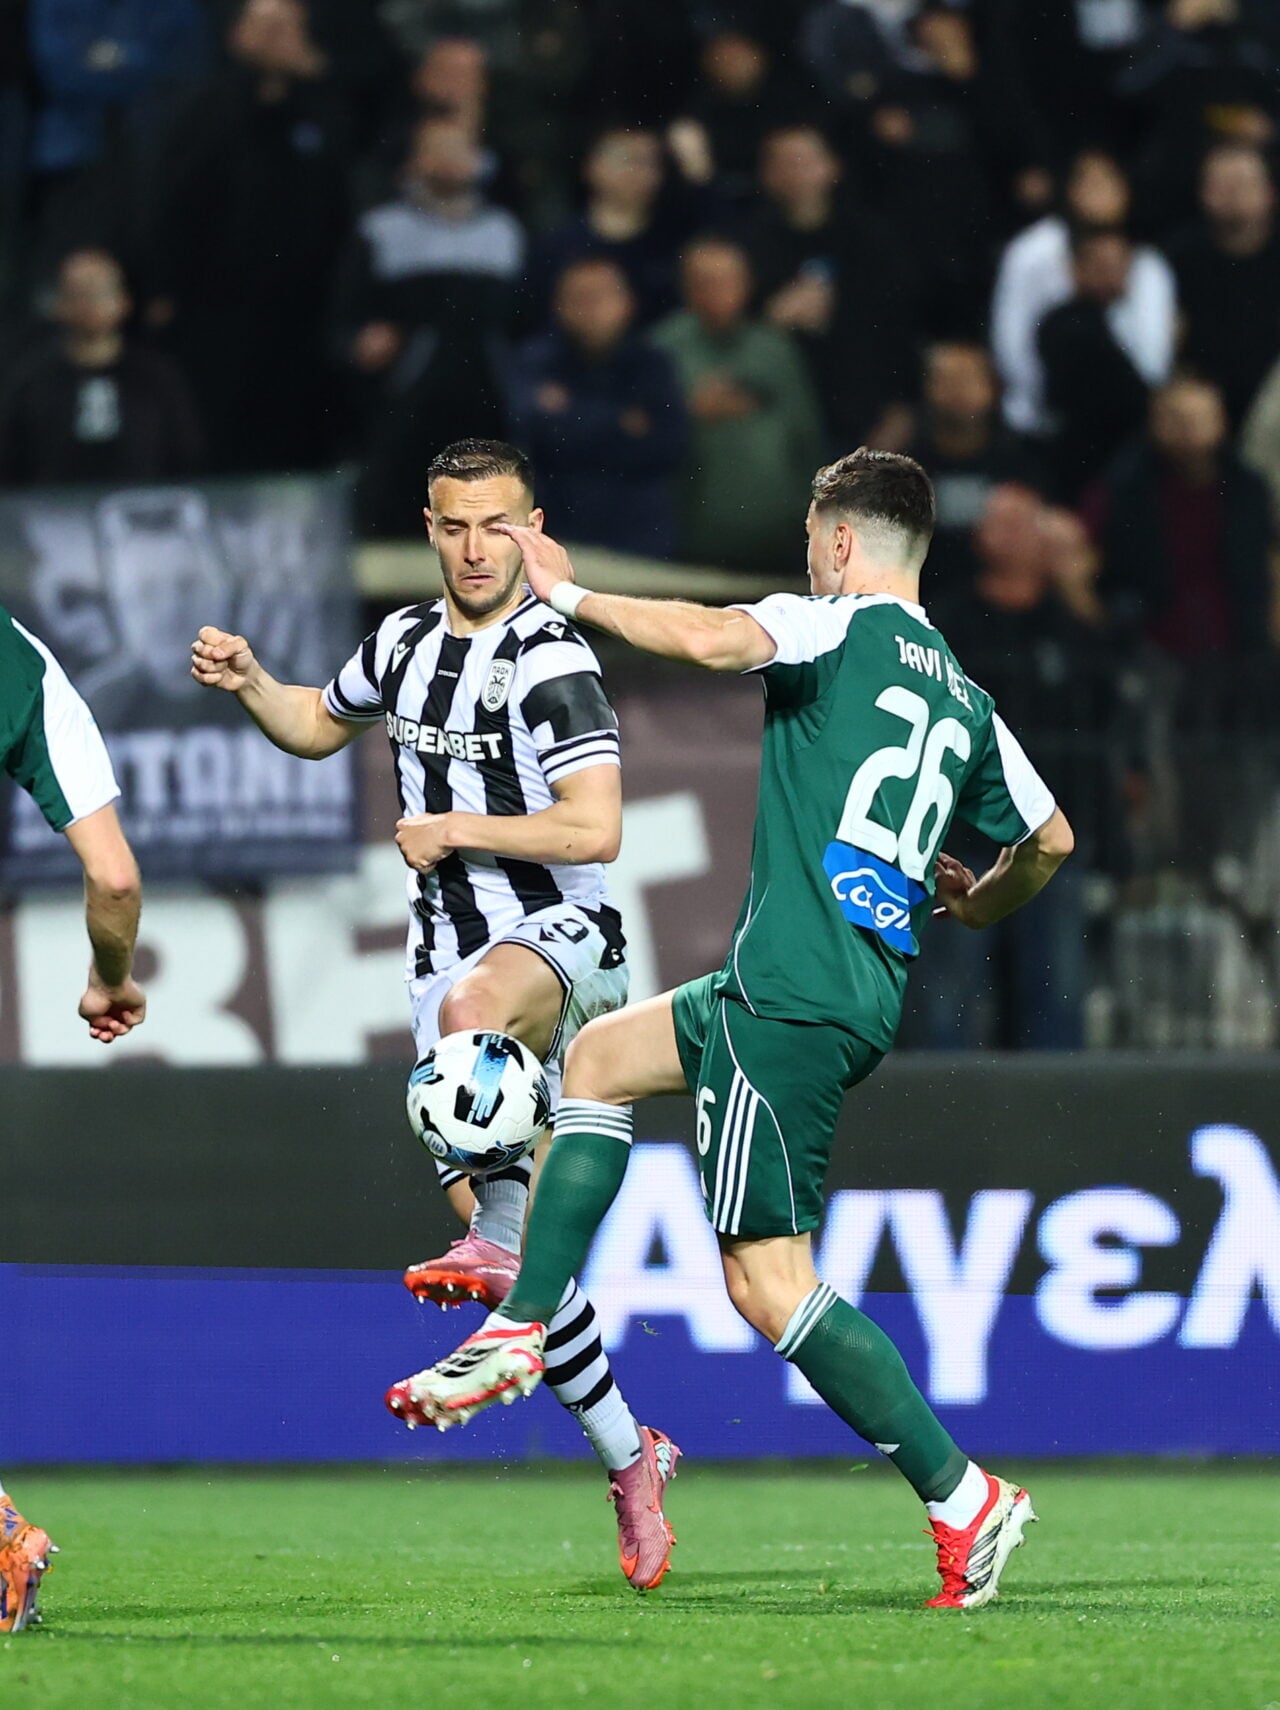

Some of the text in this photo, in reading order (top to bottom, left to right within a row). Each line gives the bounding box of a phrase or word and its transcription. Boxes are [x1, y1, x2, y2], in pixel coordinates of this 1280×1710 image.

[894, 634, 943, 682] JAVI
[385, 710, 503, 761] SUPERBET
[835, 685, 972, 882] 26
